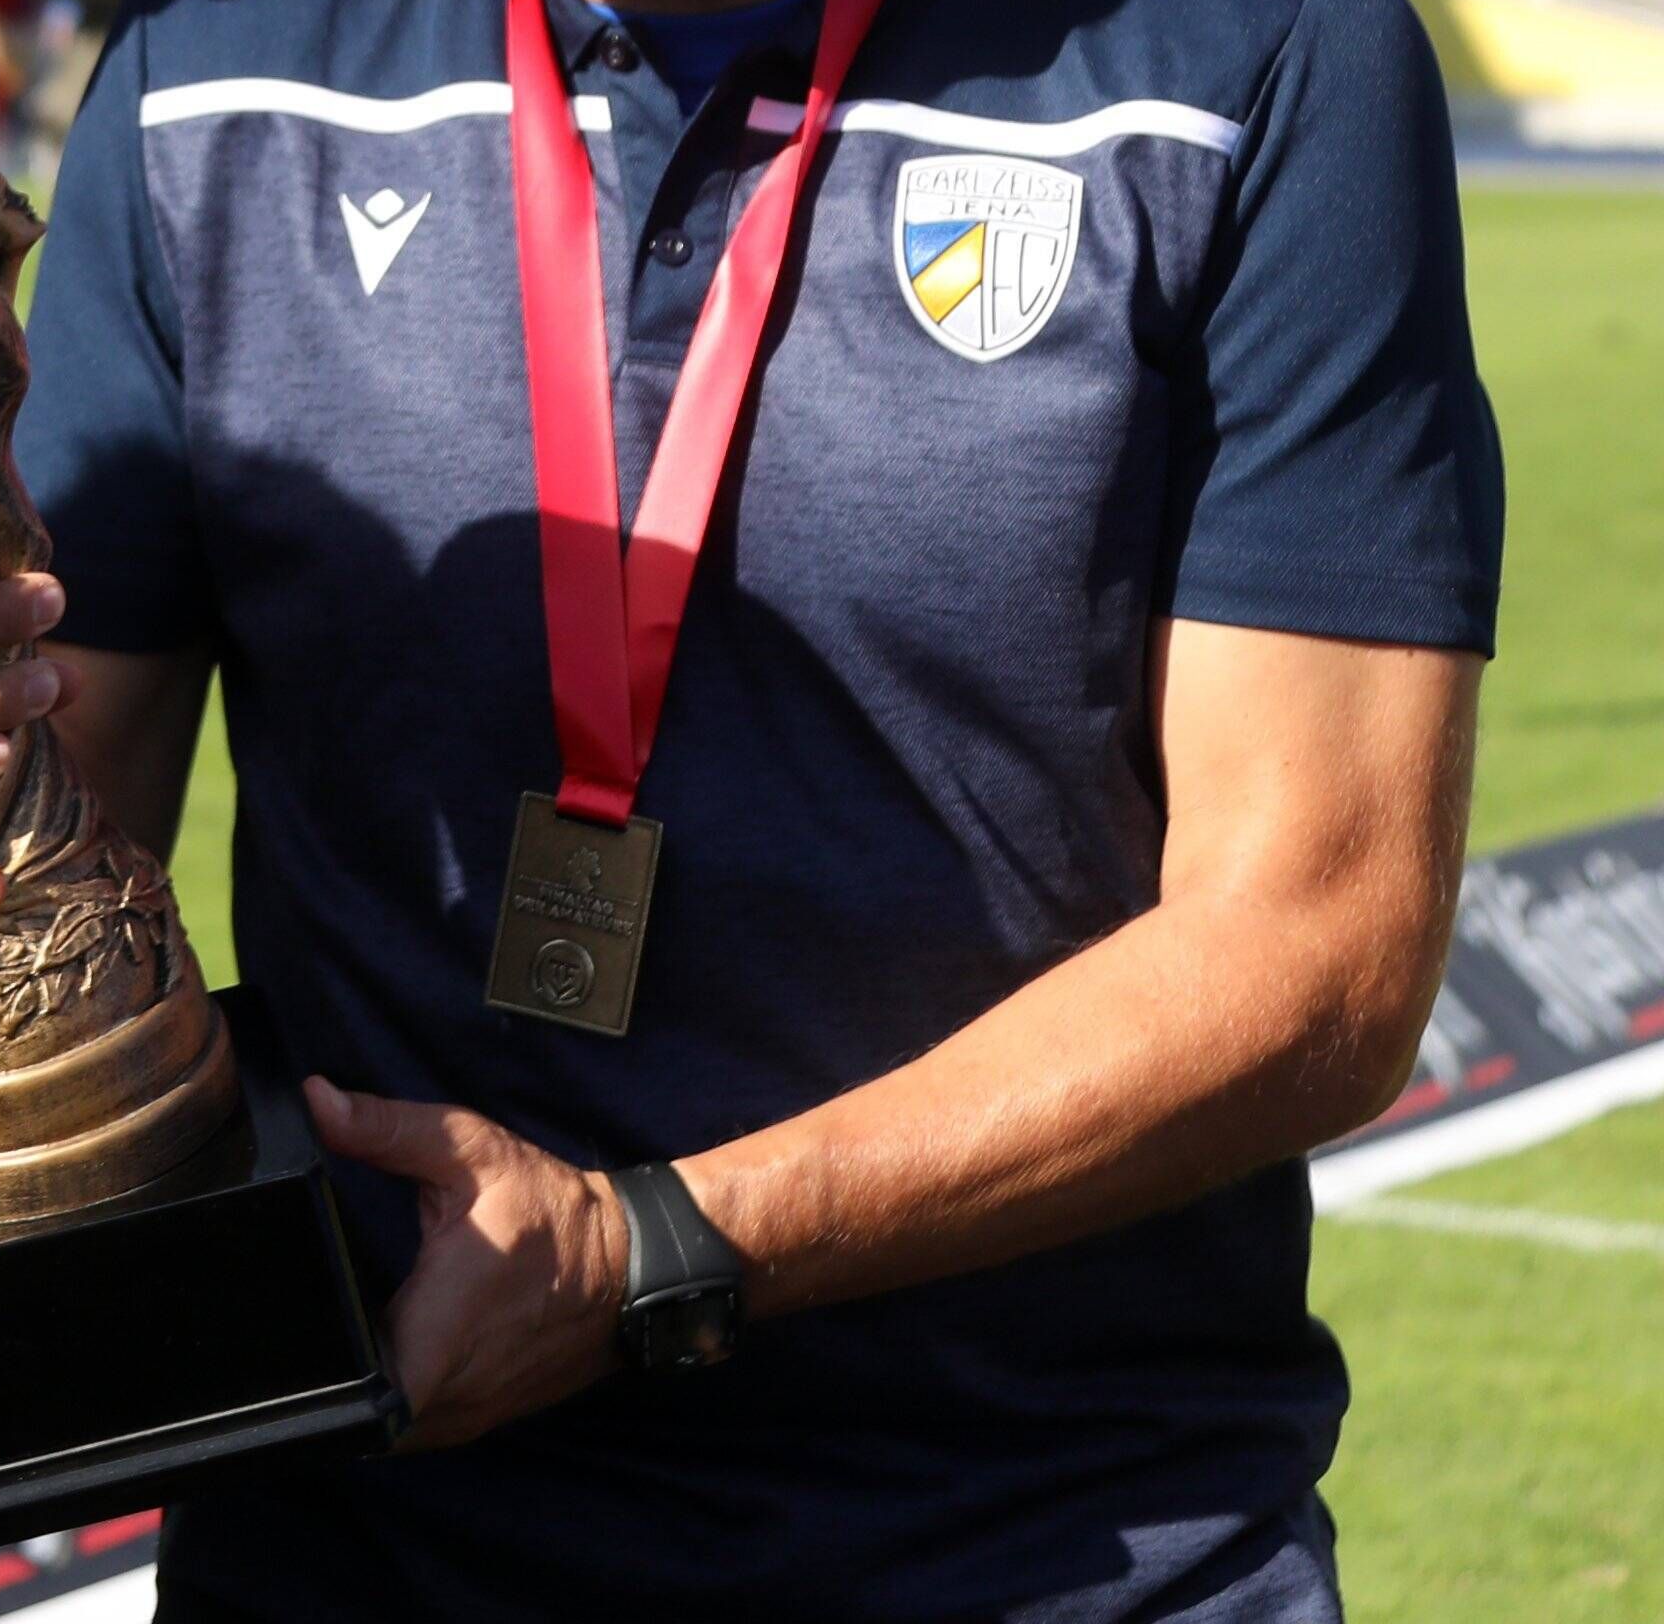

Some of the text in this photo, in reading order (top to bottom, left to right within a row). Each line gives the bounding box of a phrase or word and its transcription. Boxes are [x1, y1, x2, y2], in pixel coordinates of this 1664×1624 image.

[915, 167, 1067, 199] CARL ZEISS
[939, 199, 1036, 219] JENA
